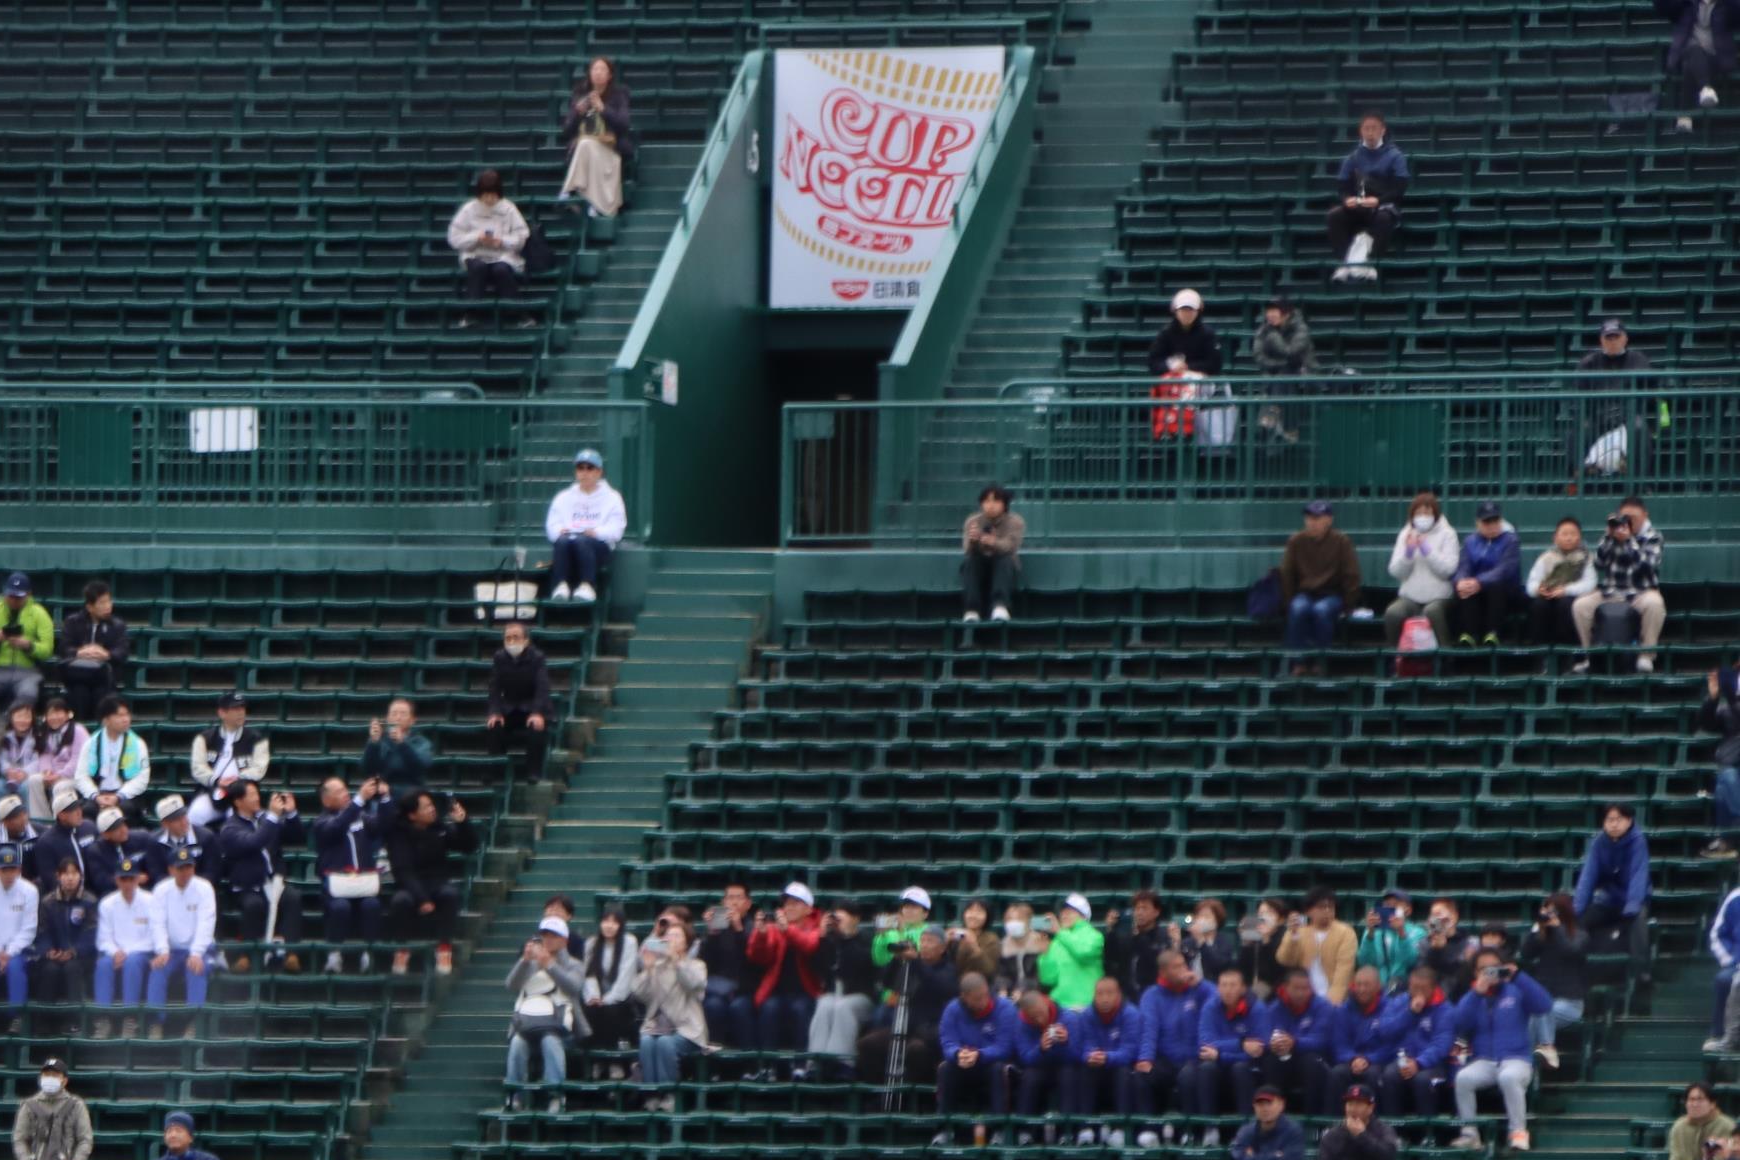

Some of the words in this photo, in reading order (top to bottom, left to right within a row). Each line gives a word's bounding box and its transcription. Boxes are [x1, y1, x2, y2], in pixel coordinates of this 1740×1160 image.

[779, 113, 964, 227] NOODL
[820, 87, 976, 173] CUP
[872, 280, 920, 299] 日清食
